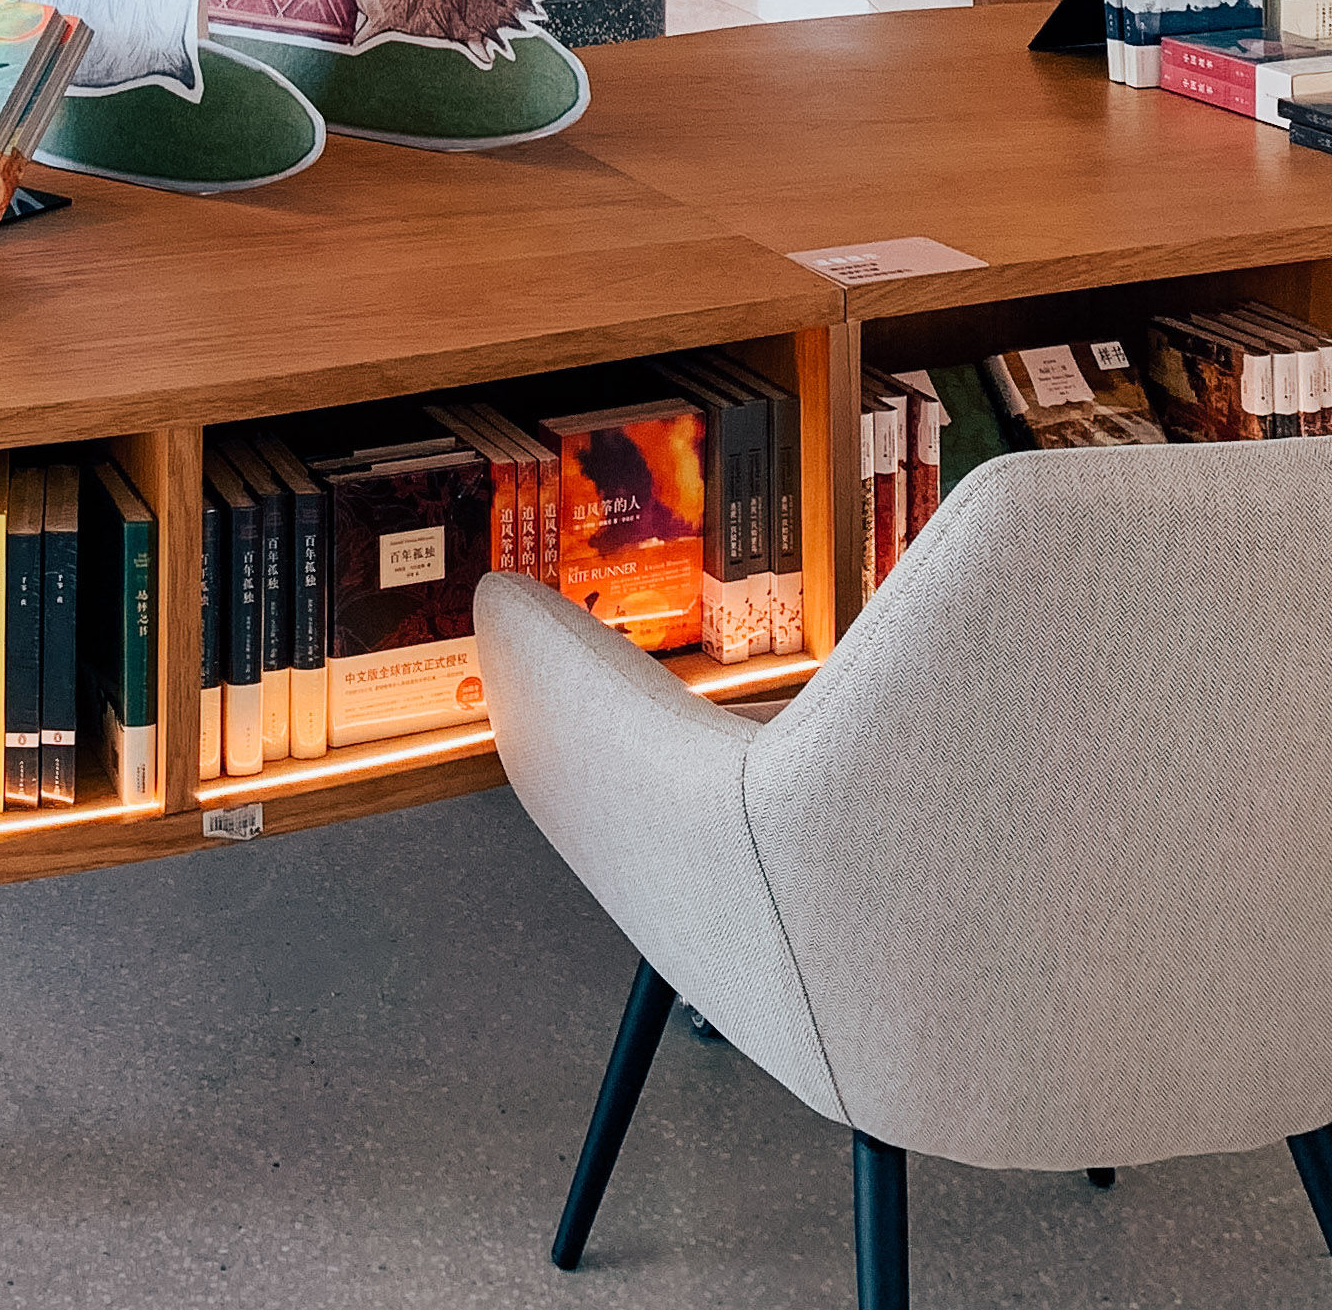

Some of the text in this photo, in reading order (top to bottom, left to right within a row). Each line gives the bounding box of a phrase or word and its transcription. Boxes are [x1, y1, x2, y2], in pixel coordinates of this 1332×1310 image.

[573, 495, 641, 521] 追风筝的人
[267, 536, 279, 590] 百年孤独
[304, 534, 317, 587] 百年孤独
[390, 545, 436, 565] 百年孤独
[500, 508, 514, 572] 追风筝的
[521, 506, 535, 579] 追风筝的人
[545, 502, 558, 578] 追风筝的人
[243, 551, 255, 604] 百年孤独
[568, 569, 590, 584] KITE
[592, 562, 637, 580] RUNNER
[345, 652, 468, 686] 中文版全球首次正式授权
